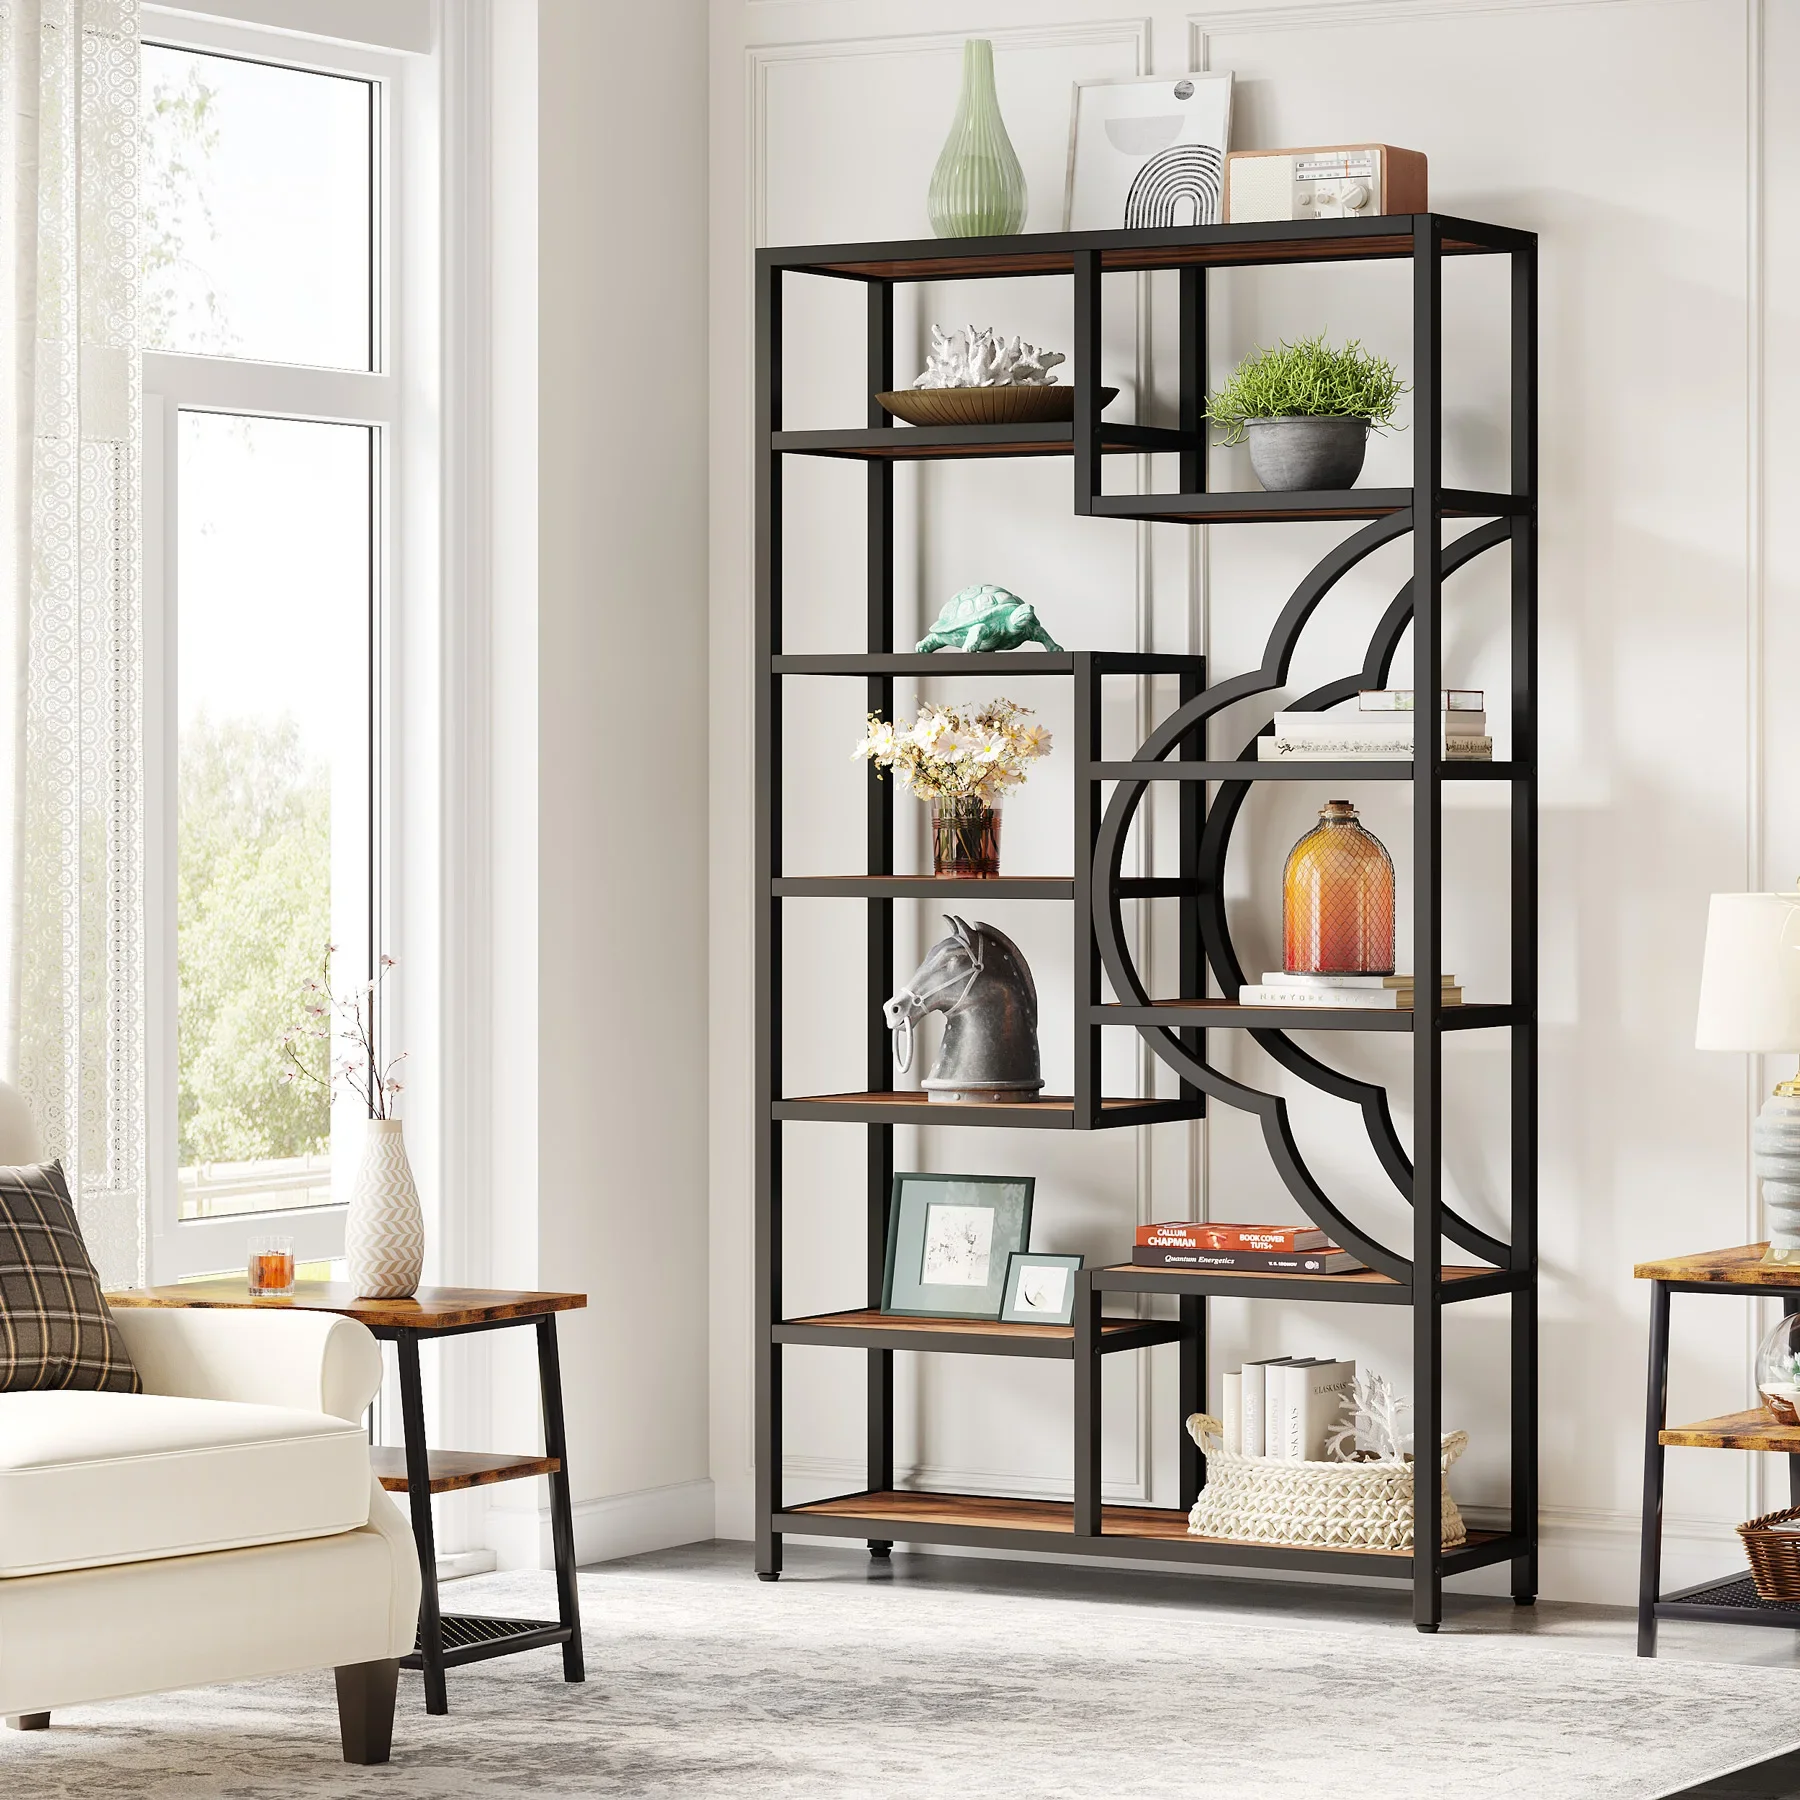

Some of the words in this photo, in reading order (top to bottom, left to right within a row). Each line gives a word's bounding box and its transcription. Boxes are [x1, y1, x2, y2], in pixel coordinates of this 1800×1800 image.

[1157, 1229, 1186, 1237] CALLUM
[1147, 1237, 1196, 1248] CHAPMAN
[1240, 1234, 1260, 1242] BOOK
[1260, 1235, 1285, 1243] COVER
[1251, 1242, 1273, 1250] TUTS+
[1164, 1254, 1197, 1263] Quantum
[1198, 1256, 1235, 1265] Energetics
